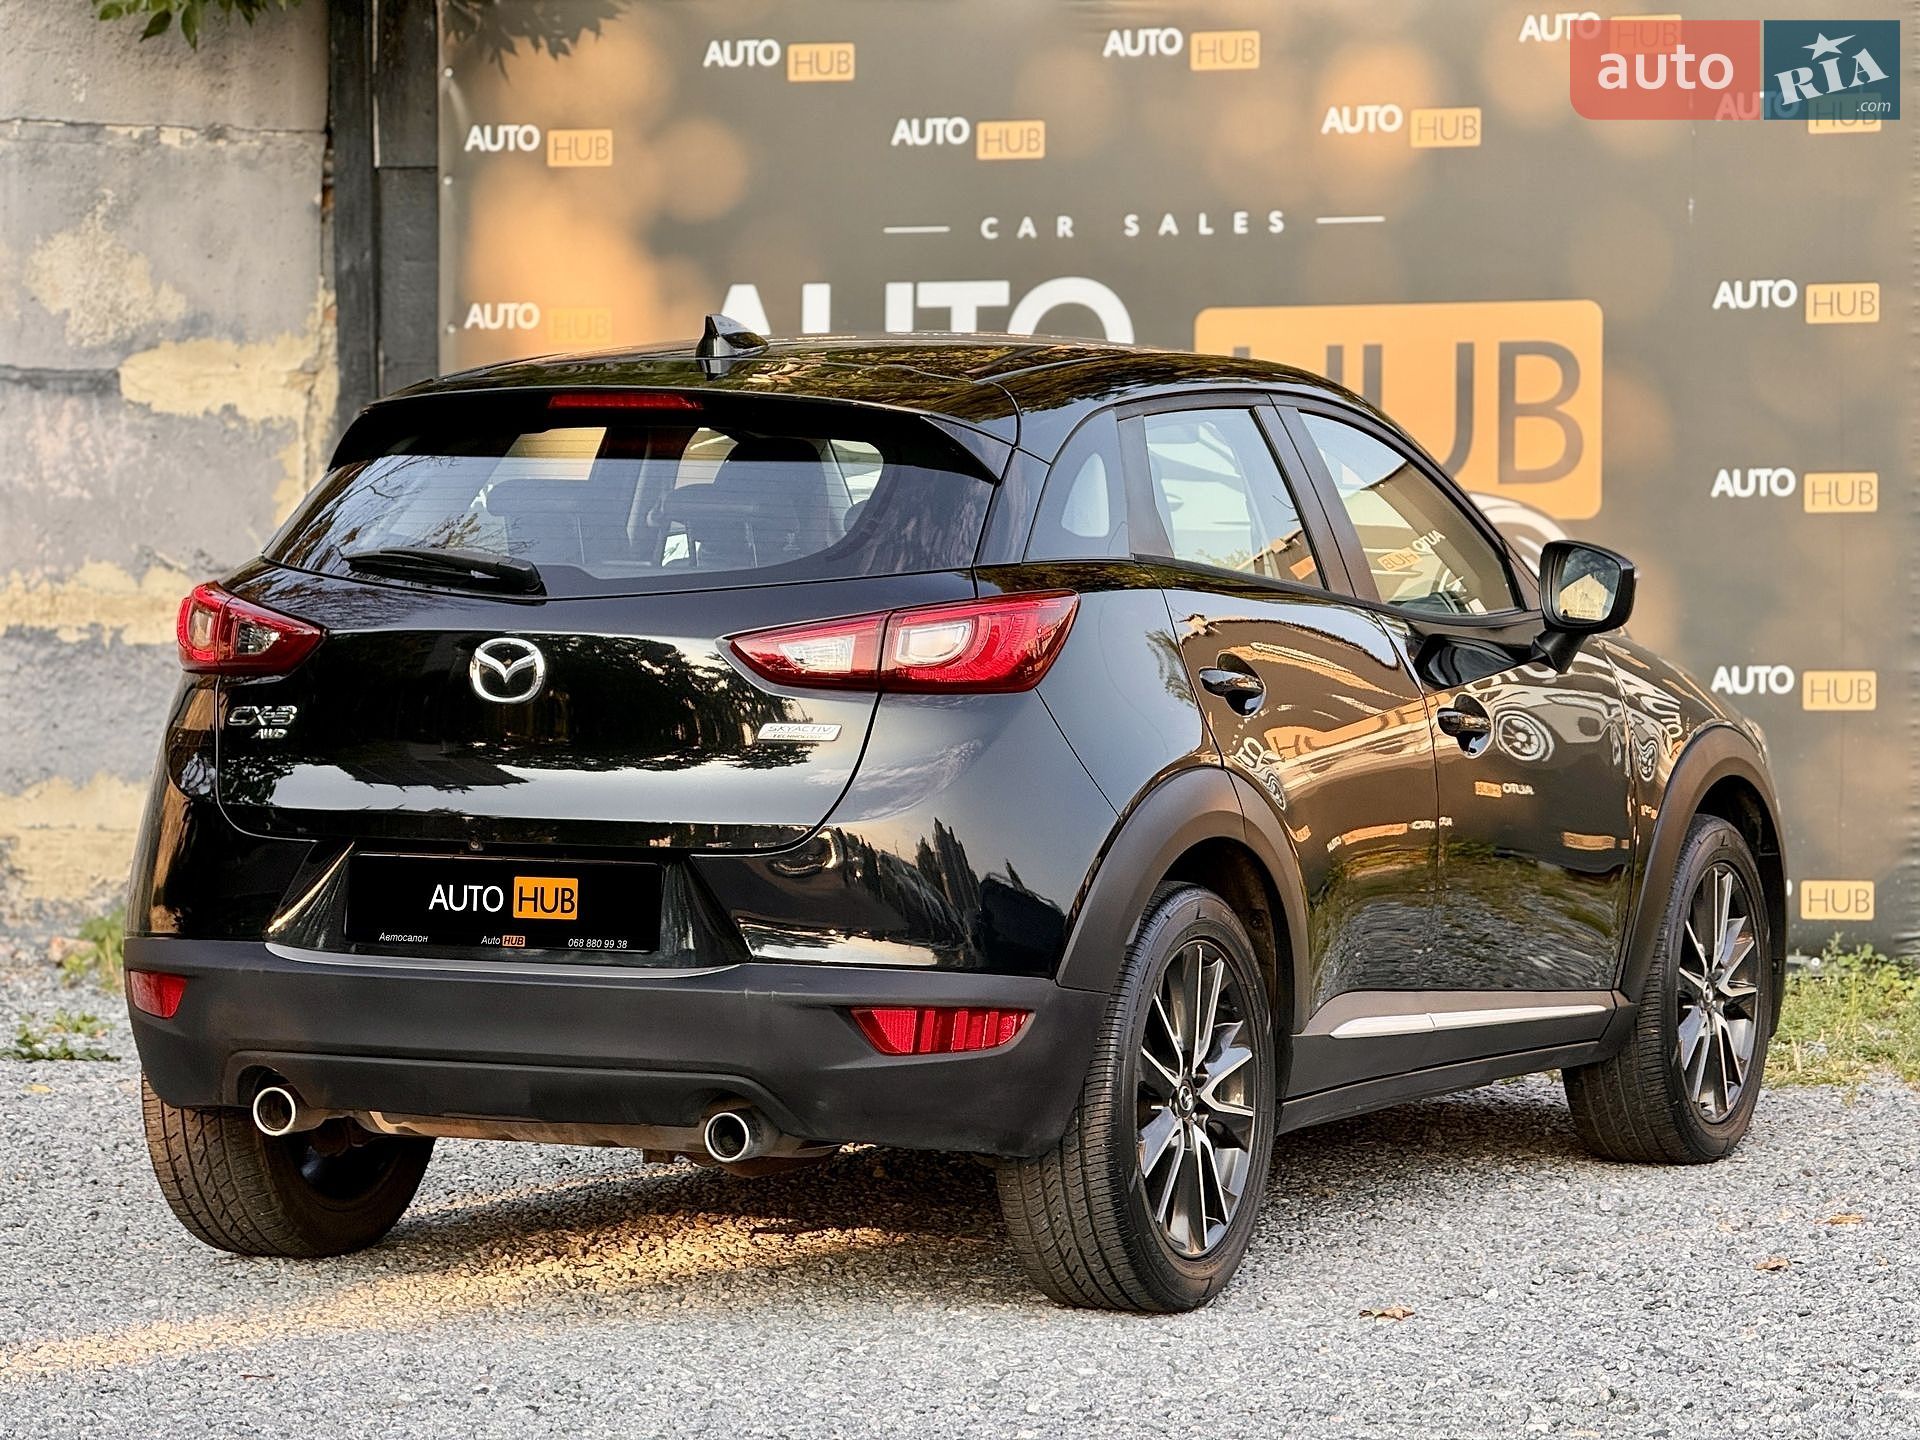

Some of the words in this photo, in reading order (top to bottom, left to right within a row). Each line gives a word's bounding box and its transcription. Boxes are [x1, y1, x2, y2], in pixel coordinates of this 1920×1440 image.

[1519, 12, 1600, 43] AUTO
[704, 39, 781, 68] AUTO
[793, 50, 852, 76] HUB
[1103, 28, 1184, 58] AUTO
[1197, 38, 1257, 64] HUB
[891, 117, 970, 146] AUTO
[983, 127, 1041, 153] HUB
[1322, 105, 1402, 134] AUTO
[1418, 115, 1478, 141] HUB
[465, 124, 540, 152] AUTO
[553, 135, 610, 161] HUB
[981, 215, 1075, 240] CAR
[1123, 211, 1286, 237] SALES
[1712, 279, 1798, 310] AUTO
[1813, 291, 1876, 317] HUB
[464, 303, 540, 330] AUTO
[553, 313, 609, 339] HUB
[1232, 340, 1587, 486] UB
[1711, 468, 1796, 498] AUTO
[1812, 480, 1874, 506] HUB
[1711, 665, 1795, 695] AUTO
[1810, 678, 1872, 704] HUB
[429, 884, 504, 913] AUTO
[518, 886, 575, 914] HUB
[1807, 888, 1869, 914] HUB
[378, 932, 429, 943] Автосалон
[481, 936, 501, 946] Auto
[504, 937, 525, 946] HUB
[568, 938, 585, 948] 068
[586, 939, 602, 948] 880
[603, 939, 615, 949] 99
[616, 939, 628, 949] 38
